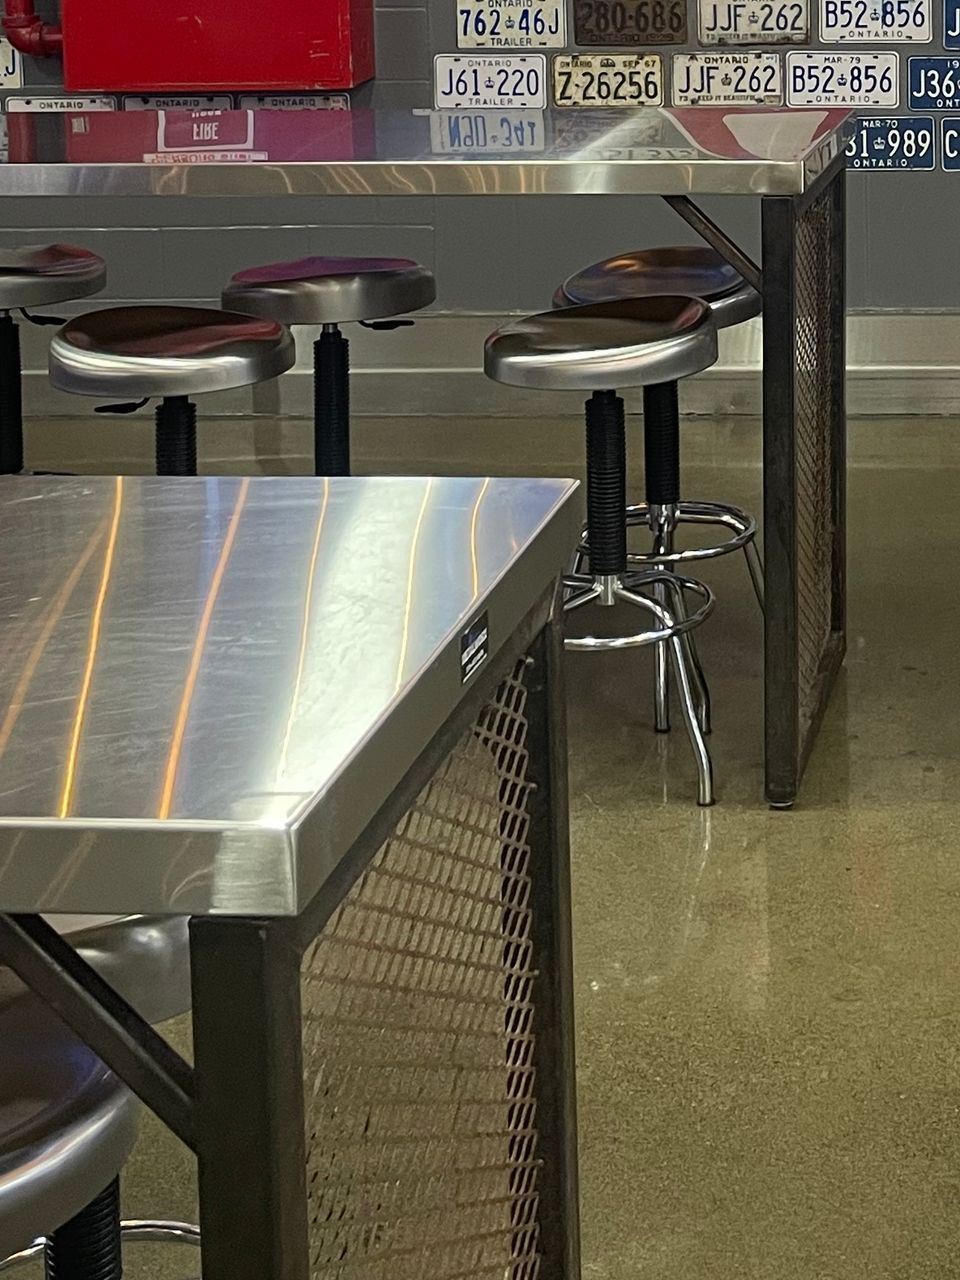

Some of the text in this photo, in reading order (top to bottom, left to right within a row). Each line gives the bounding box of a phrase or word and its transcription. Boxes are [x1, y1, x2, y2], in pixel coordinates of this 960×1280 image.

[460, 8, 559, 36] 762 46J
[490, 38, 532, 46] TRAILER
[824, 56, 861, 64] MAR-79
[442, 69, 539, 96] J61 220
[792, 65, 892, 93] B52 856
